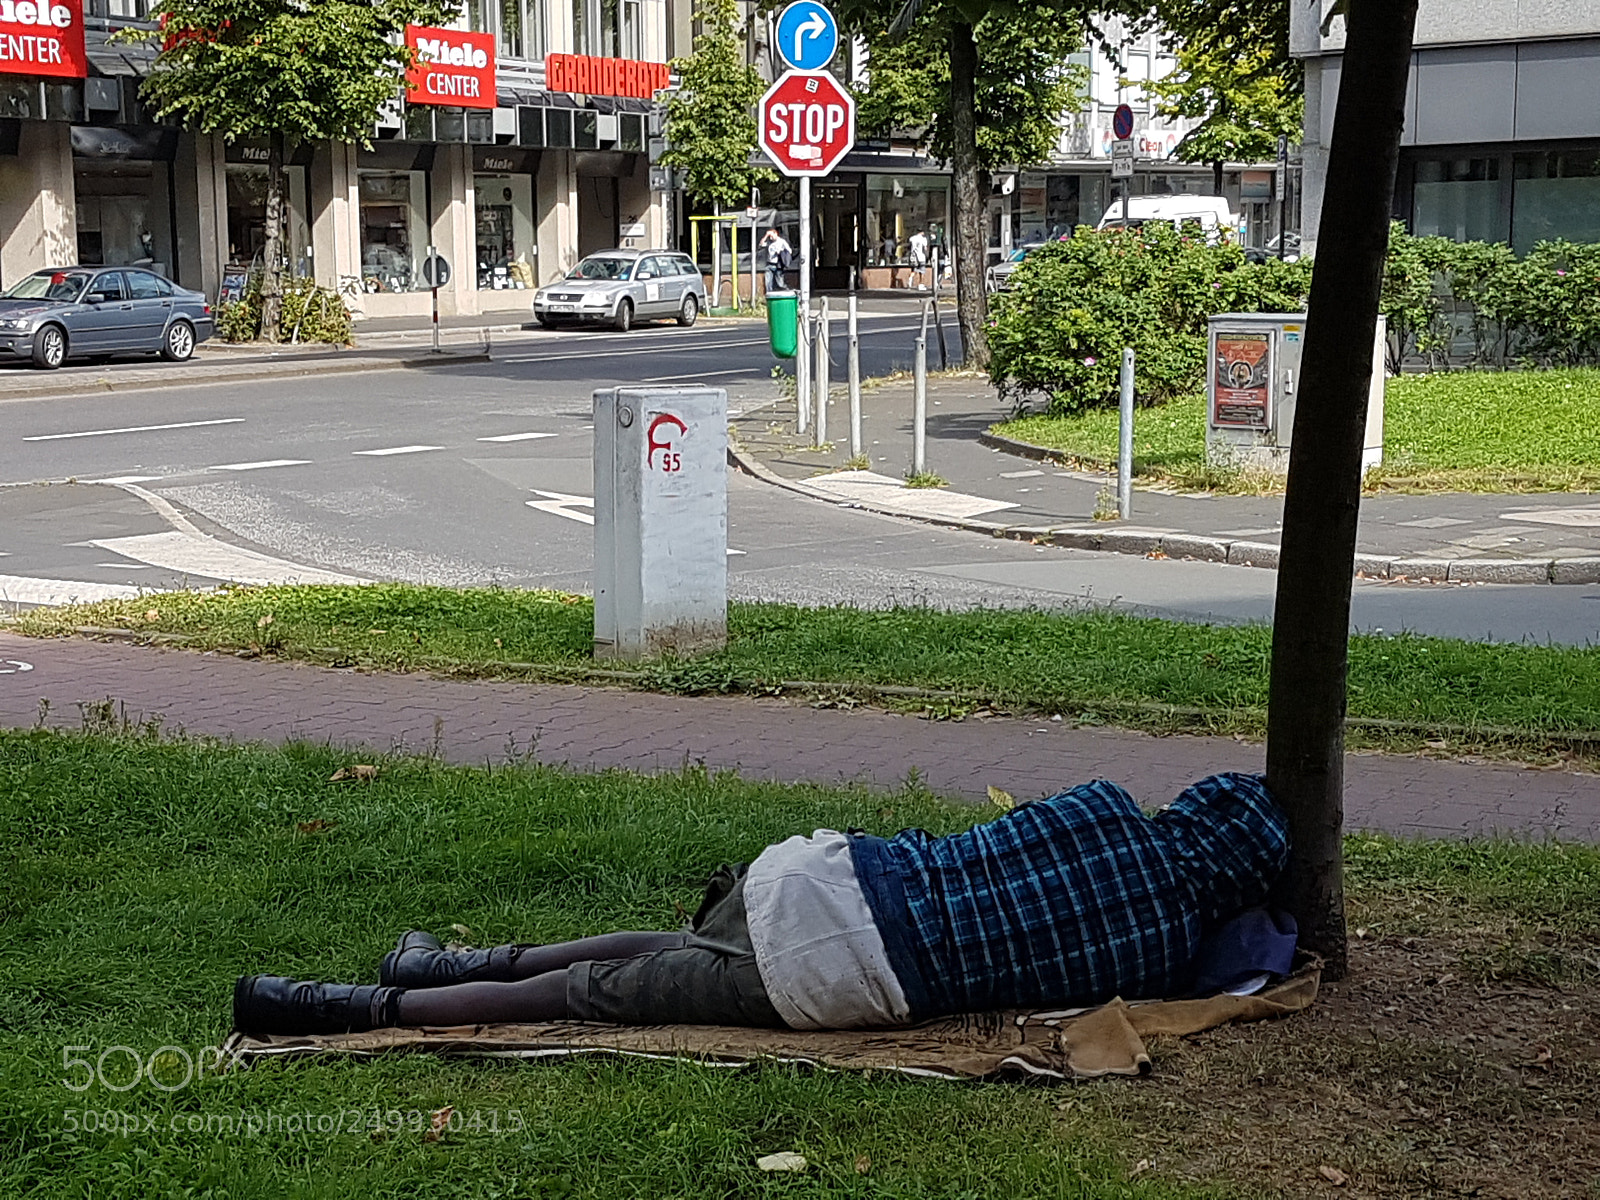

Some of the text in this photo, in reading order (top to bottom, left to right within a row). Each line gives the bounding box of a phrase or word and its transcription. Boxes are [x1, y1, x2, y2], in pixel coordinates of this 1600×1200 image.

[0, 0, 72, 28] iele
[0, 33, 62, 64] ENTER
[416, 37, 488, 69] Miele
[426, 72, 480, 98] CENTER
[550, 53, 670, 99] GRANDERATH
[769, 102, 845, 144] STOP
[483, 158, 514, 170] Miele
